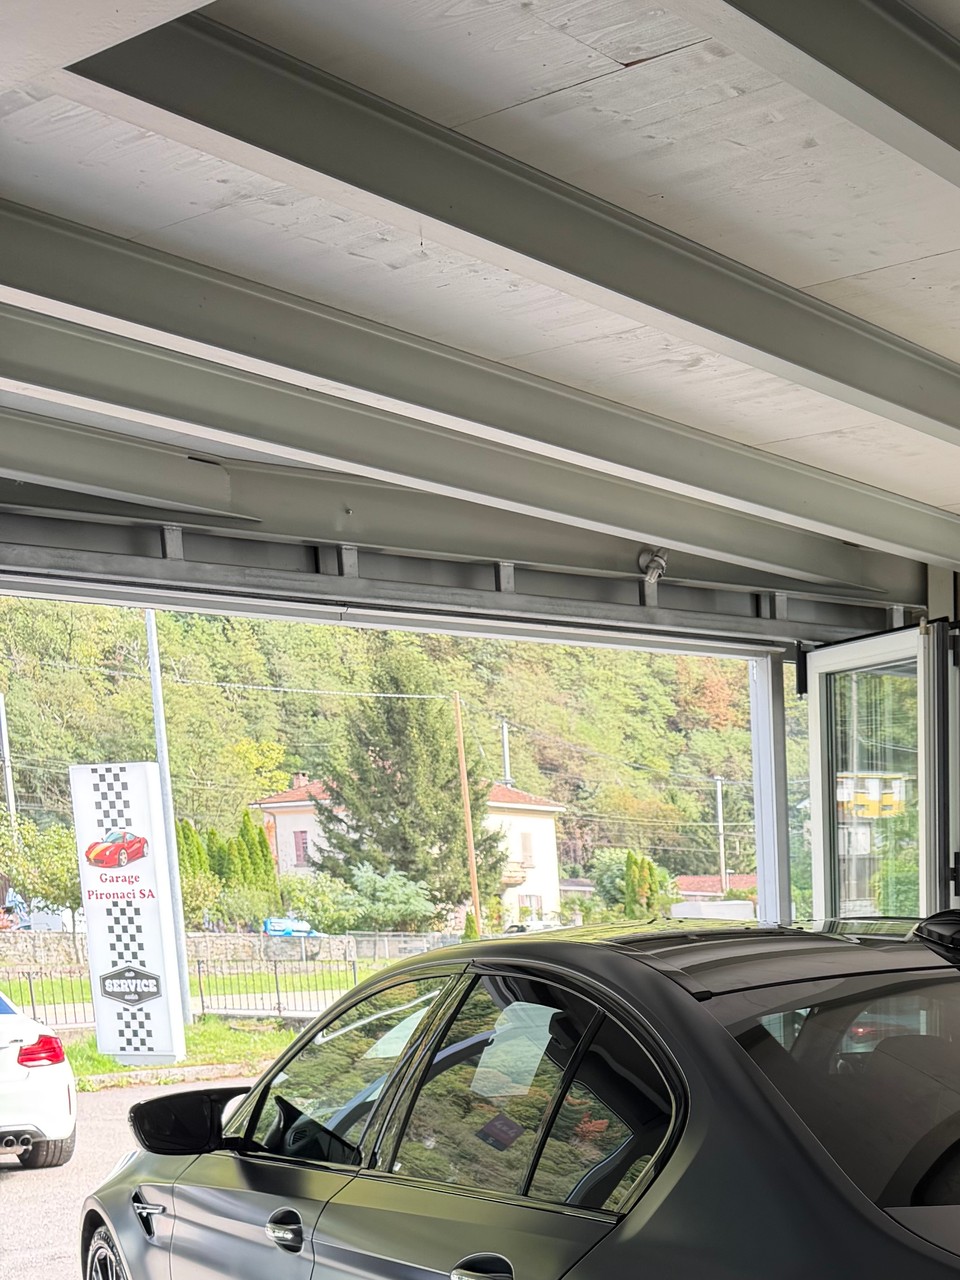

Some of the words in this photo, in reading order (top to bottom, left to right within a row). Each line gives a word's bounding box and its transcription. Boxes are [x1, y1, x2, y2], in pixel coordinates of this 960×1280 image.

[99, 873, 140, 885] Garage
[87, 889, 136, 900] Pironaci
[139, 889, 155, 899] SA
[104, 978, 157, 993] SERVICE
